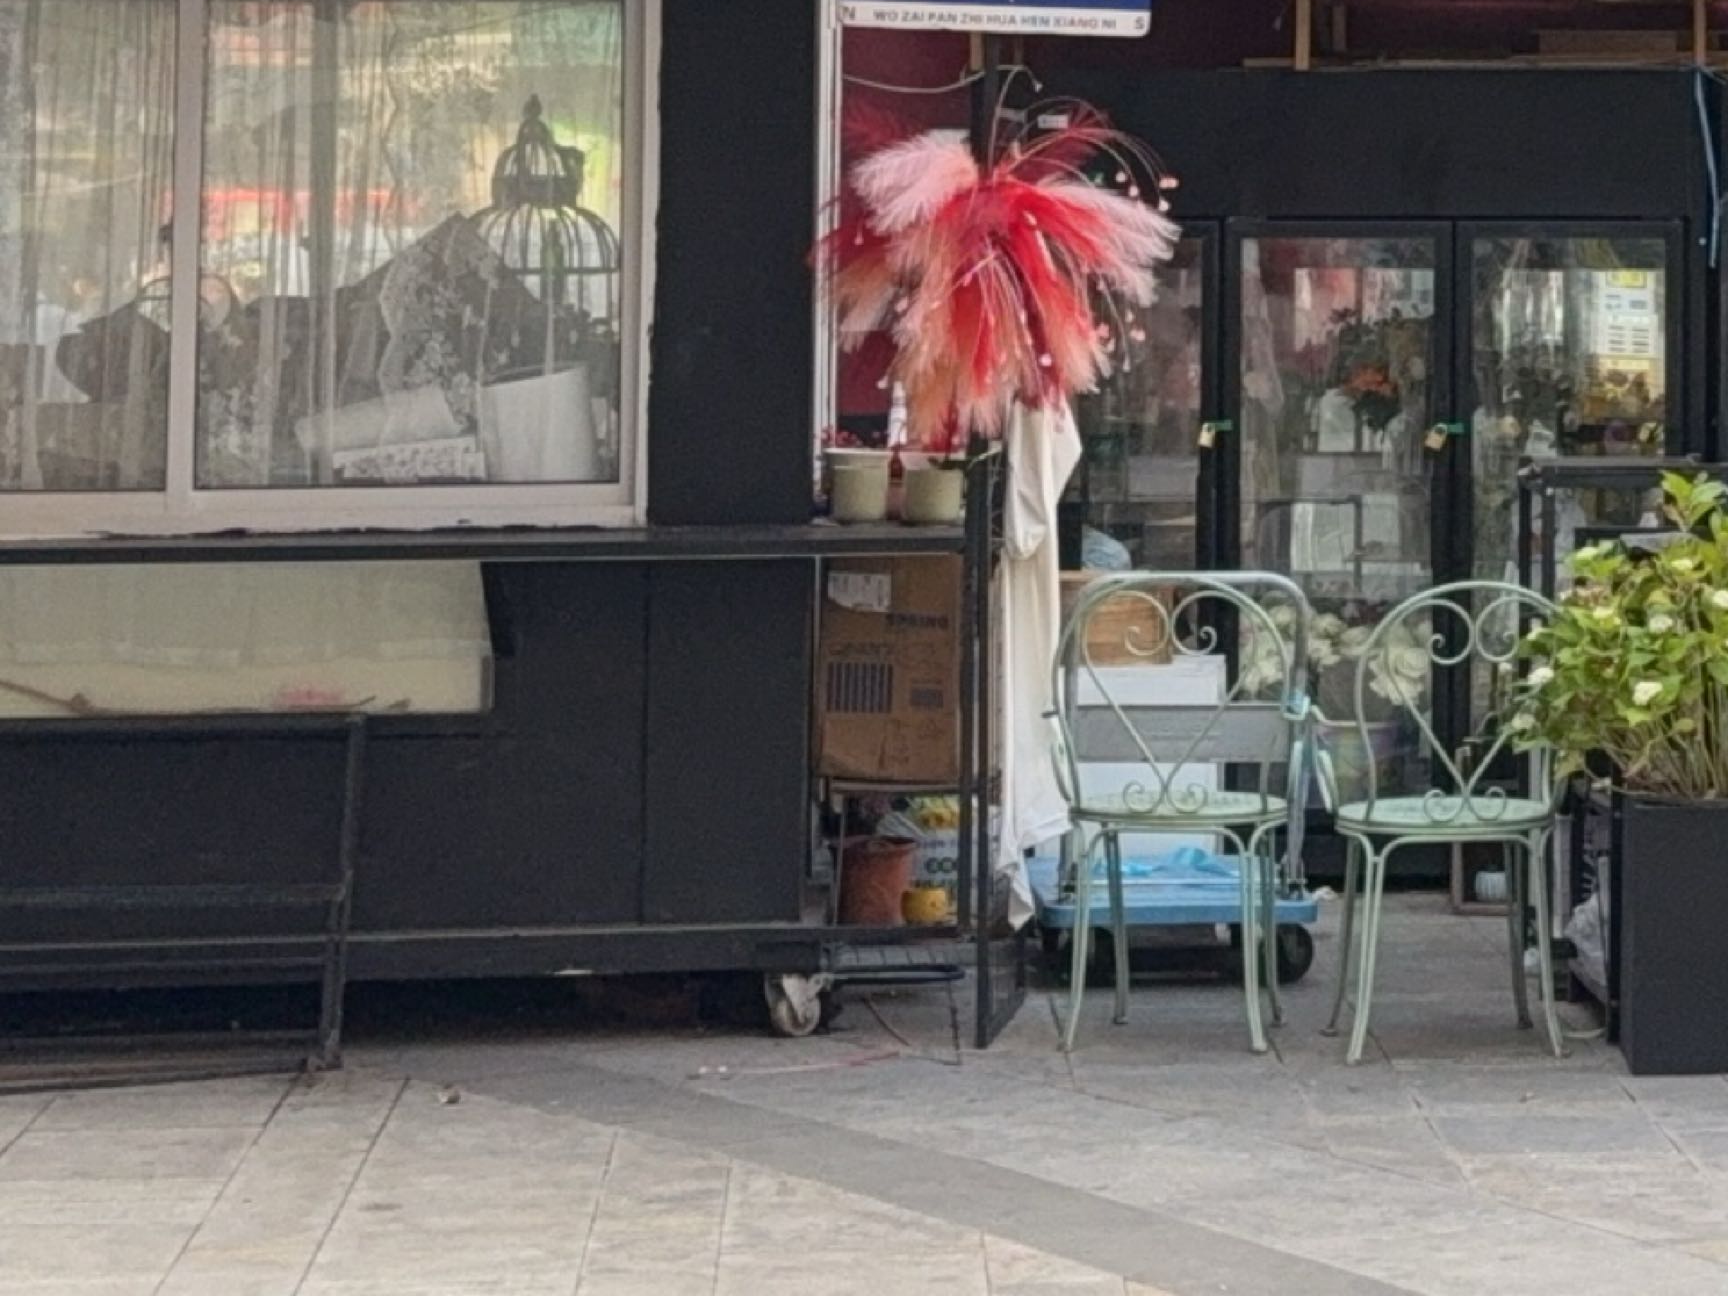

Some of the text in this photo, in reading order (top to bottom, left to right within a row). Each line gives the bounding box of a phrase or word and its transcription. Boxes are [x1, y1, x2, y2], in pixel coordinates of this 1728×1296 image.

[873, 10, 898, 23] WO
[901, 11, 925, 24] ZAI
[928, 11, 957, 24] PAN
[959, 12, 983, 25] ZHI
[986, 13, 1017, 26] HUA
[1019, 14, 1051, 27] HEN
[1053, 16, 1098, 28] XIANG
[1101, 18, 1117, 29] NI
[1133, 17, 1145, 30] S
